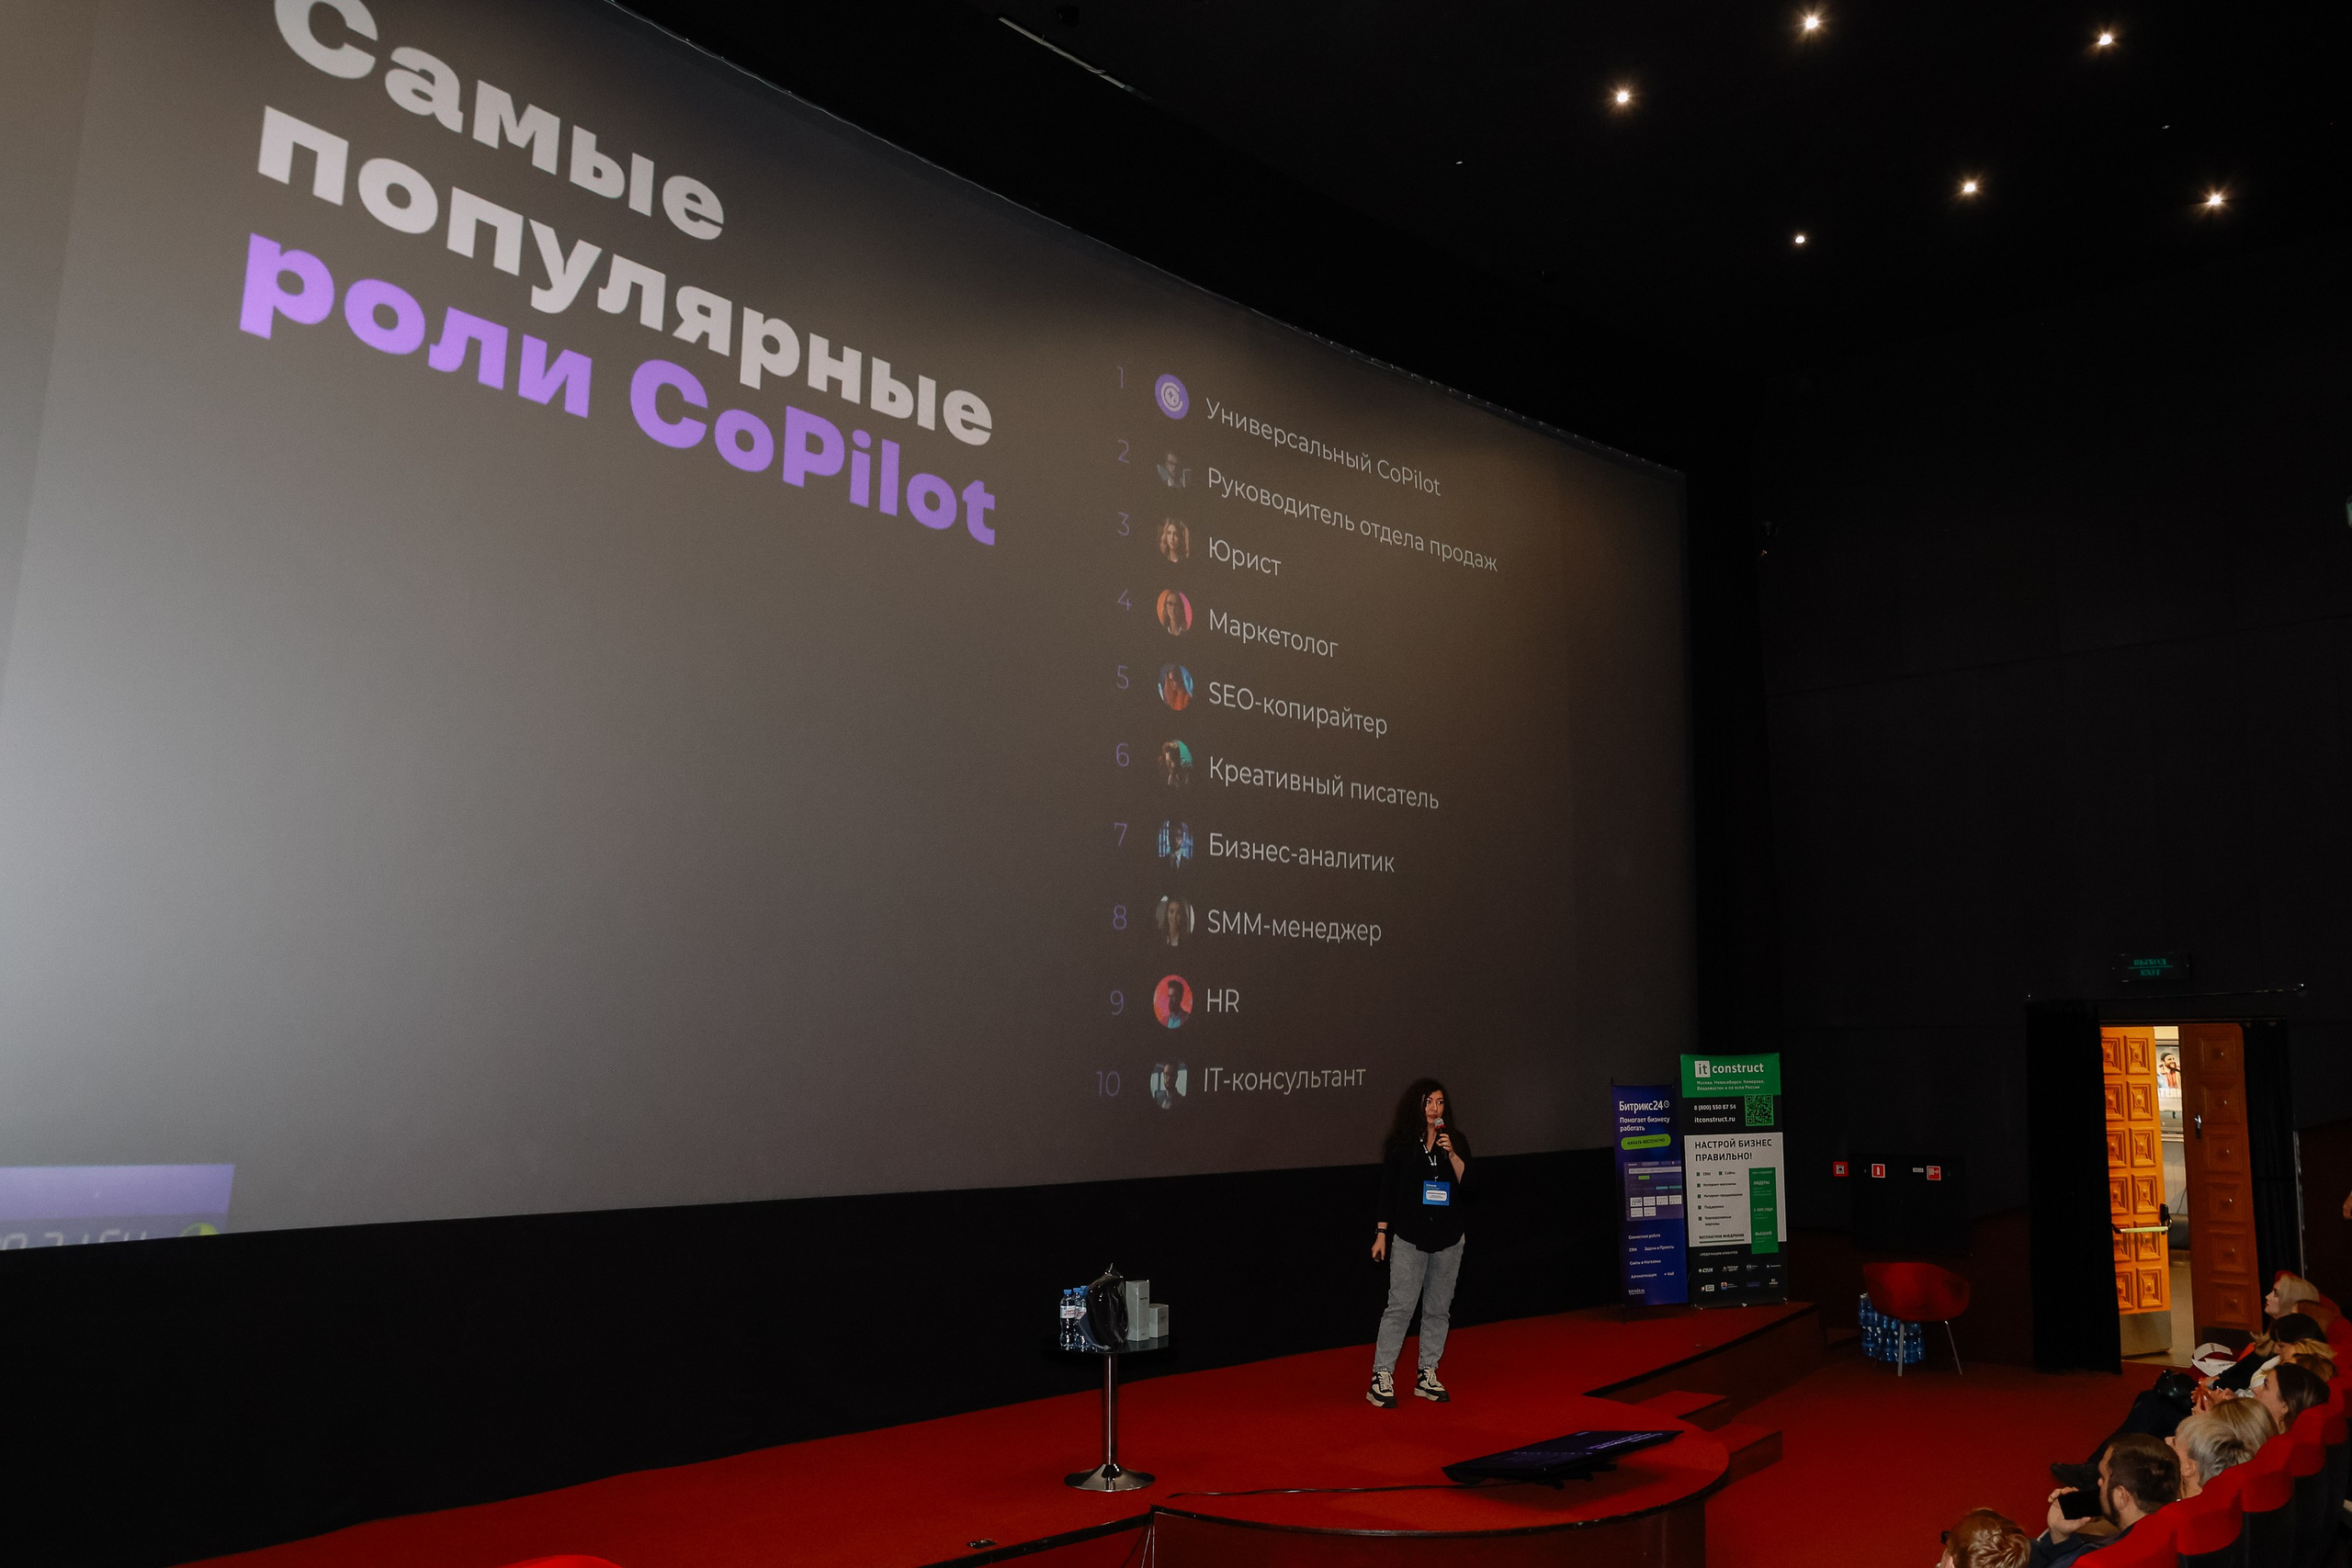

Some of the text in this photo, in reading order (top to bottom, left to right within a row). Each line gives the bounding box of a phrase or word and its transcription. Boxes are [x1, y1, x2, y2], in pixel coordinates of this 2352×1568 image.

[274, 0, 724, 240] Самые
[258, 106, 993, 446] популярные
[239, 232, 996, 547] роли CoPilot
[1116, 367, 1442, 496] 1 Универсальный CoPilot
[1117, 440, 1498, 572] 2 Руководитель отдела продаж
[1117, 512, 1282, 576] 3 Юрист
[1117, 589, 1339, 658] 4 Маркетолог
[1116, 665, 1387, 739] 5 SEO-копирайтер
[1115, 743, 1440, 810] 6 Креативный писатель
[1114, 823, 1395, 873] 7 Бизнес-аналитик
[1112, 905, 1382, 946] 8 SMM-менеджер
[2133, 958, 2166, 966] ВЫХОД
[1110, 988, 1239, 1015] 9 HR
[1096, 1067, 1366, 1097] 10 IT-консультант
[1712, 1063, 1764, 1074] construct
[1619, 1100, 1664, 1113] Битрикс24
[1620, 1124, 1645, 1133] работать
[1646, 1115, 1670, 1123] бизнесу
[1694, 1138, 1772, 1149] НАСТРОЙ БИЗНЕС
[1695, 1152, 1753, 1162] ПРАВИЛЬНО!
